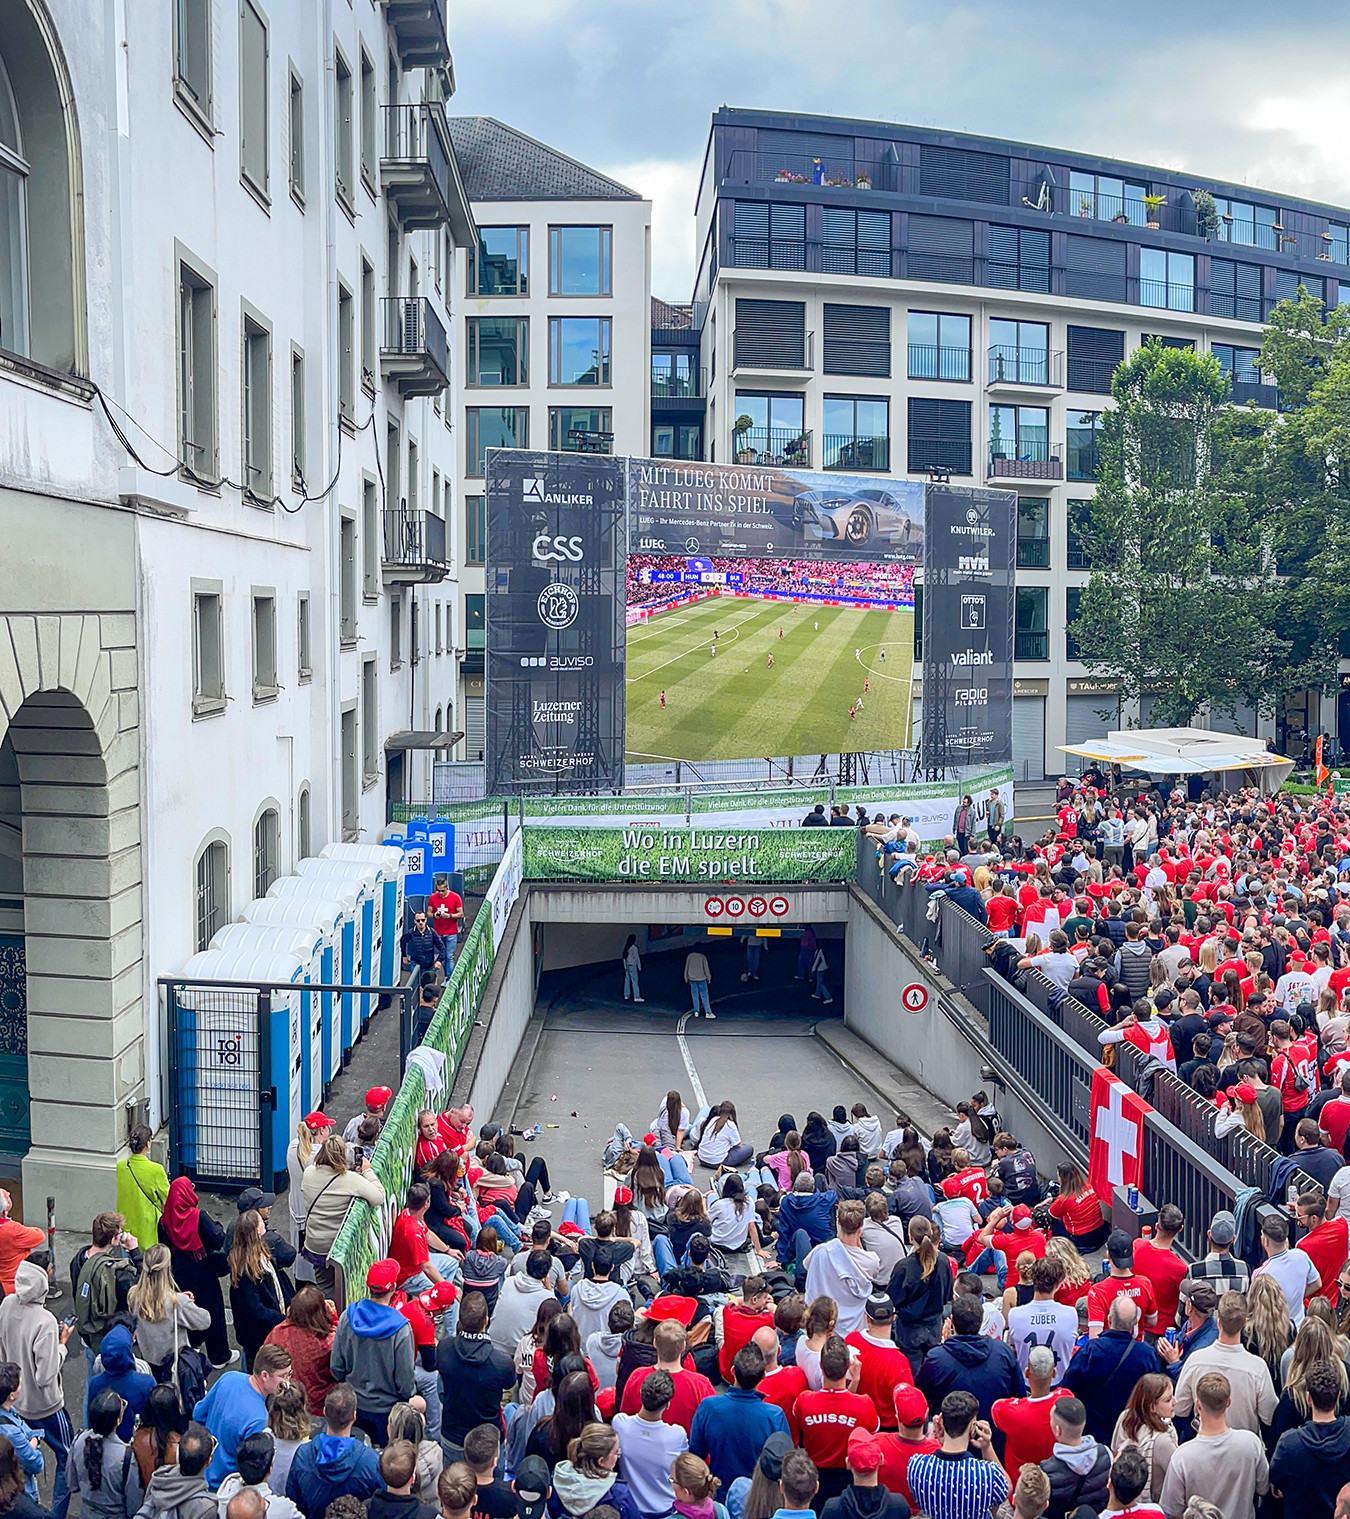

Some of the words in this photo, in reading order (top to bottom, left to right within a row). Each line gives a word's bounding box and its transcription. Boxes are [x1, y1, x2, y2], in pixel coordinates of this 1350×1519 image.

[640, 466, 670, 485] MIT
[674, 469, 714, 489] LUEG
[719, 471, 774, 493] KOMMT
[544, 493, 593, 505] ANLIKER
[640, 489, 692, 510] FAHRT
[697, 493, 723, 512] INS
[728, 495, 774, 515] SPIEL.
[639, 516, 655, 524] LUEG
[660, 517, 668, 525] Ihr
[668, 518, 709, 527] Mercedes-Benz
[710, 520, 730, 528] Partner
[743, 521, 751, 529] der
[752, 522, 774, 530] Schweiz.
[533, 535, 584, 561] CSS
[640, 538, 667, 550] LUEG.
[958, 556, 989, 571] MVM
[541, 586, 576, 604] EICHHOF
[963, 597, 984, 605] OTTO'S
[549, 656, 594, 667] auviso
[951, 648, 994, 666] valiant
[1079, 682, 1095, 690] TAG
[533, 700, 582, 712] Luzerner
[533, 711, 574, 724] Zeitung
[945, 735, 994, 746] SCHWEIZERHOF
[519, 757, 594, 769] SCHWEIZERHOF
[852, 792, 870, 800] Vielen
[871, 791, 885, 799] Dank
[886, 790, 895, 798] für
[543, 804, 566, 812] Vielen
[568, 803, 586, 812] Dank
[588, 803, 598, 811] für
[601, 803, 612, 811] die
[614, 802, 667, 812] Unterstützung!
[708, 800, 728, 809] Vielen
[730, 799, 746, 808] Dank
[747, 798, 756, 806] für
[757, 797, 768, 805] die
[770, 795, 815, 805] Unterstützung!
[466, 829, 505, 848] VILLA
[622, 830, 654, 850] Wo
[663, 829, 681, 850] in
[691, 830, 759, 850] Luzern
[537, 849, 602, 857] SCHWEIZERHOF
[779, 850, 842, 859] SCHWEIZERHOF
[408, 855, 421, 864] TOI
[408, 863, 421, 871] TOI
[619, 856, 650, 875] die
[660, 856, 690, 875] EM
[698, 855, 763, 879] spielt.
[731, 902, 740, 911] 10
[218, 1039, 241, 1052] TOI
[218, 1052, 241, 1065] TOI
[1030, 1314, 1057, 1326] ZUBER
[805, 1413, 857, 1427] SUISSE
